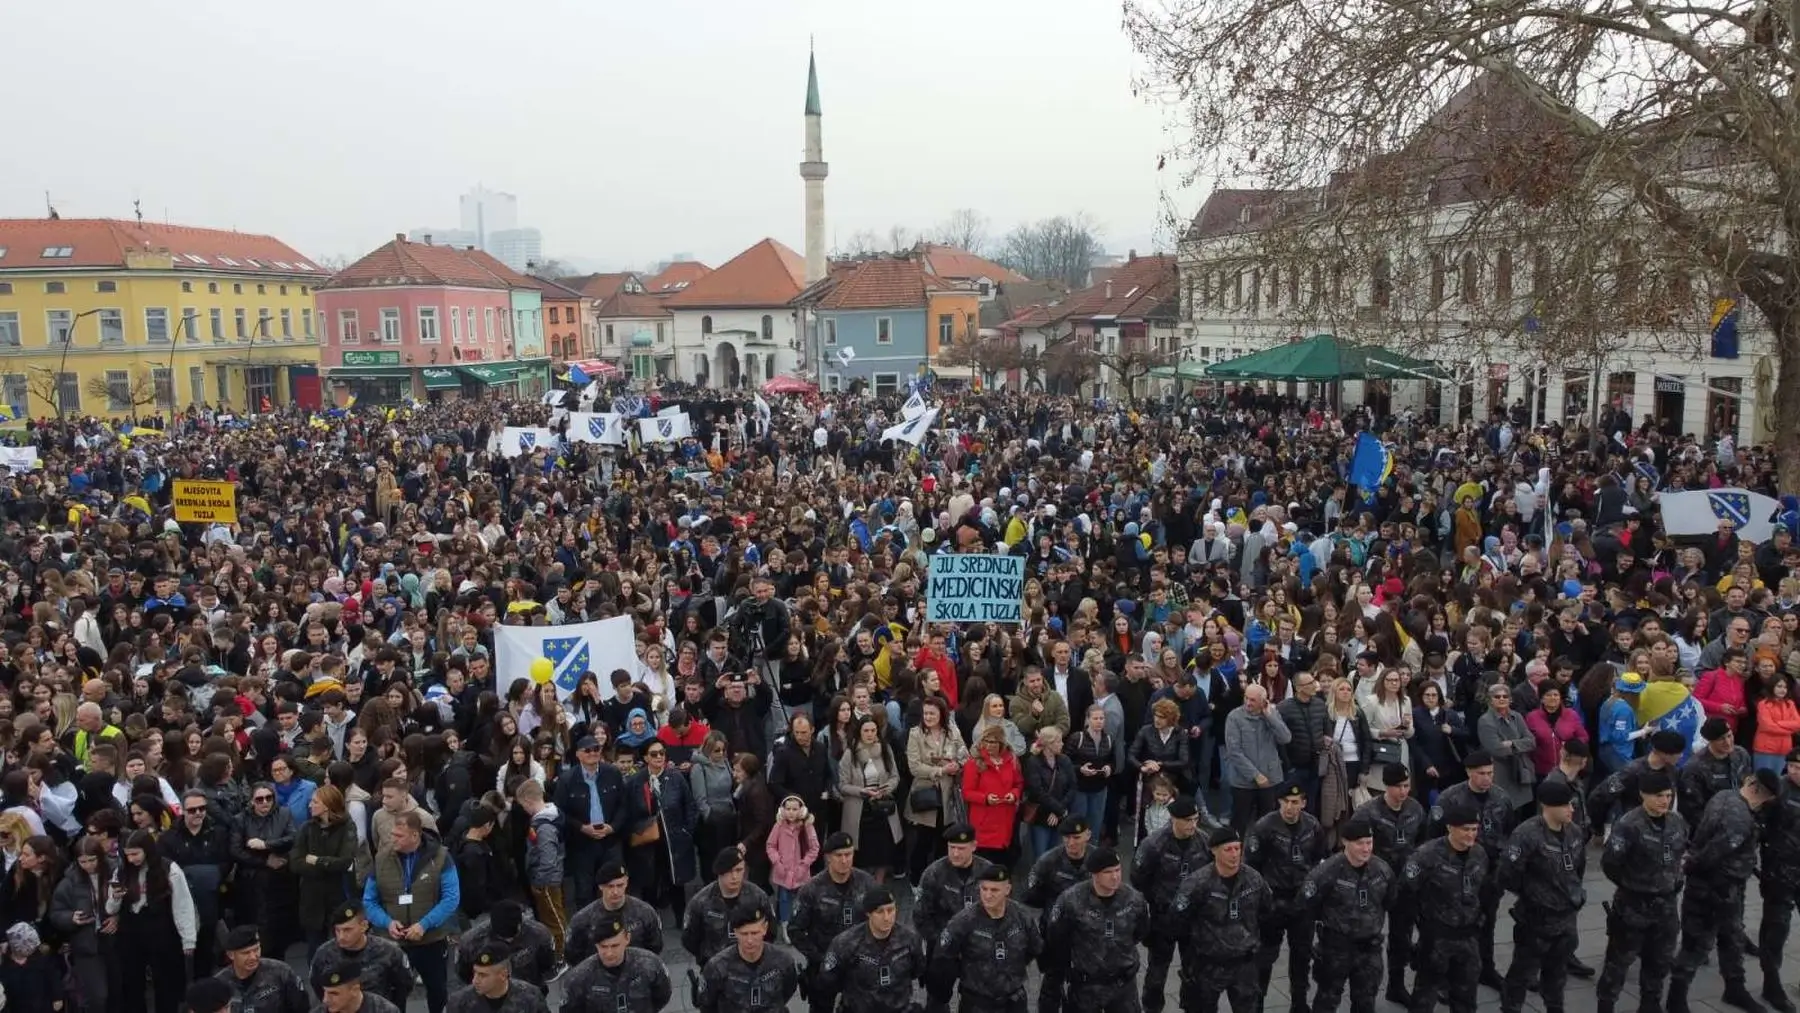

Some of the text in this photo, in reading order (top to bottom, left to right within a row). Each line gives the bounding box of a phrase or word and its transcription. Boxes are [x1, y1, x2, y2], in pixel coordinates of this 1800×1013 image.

[176, 498, 206, 508] SREDNJA
[193, 511, 215, 519] TUZLA
[960, 556, 1018, 575] SREDNJA
[932, 577, 1023, 599] MEDICINSKA
[935, 601, 1021, 620] ŠKOLA TUZLA
